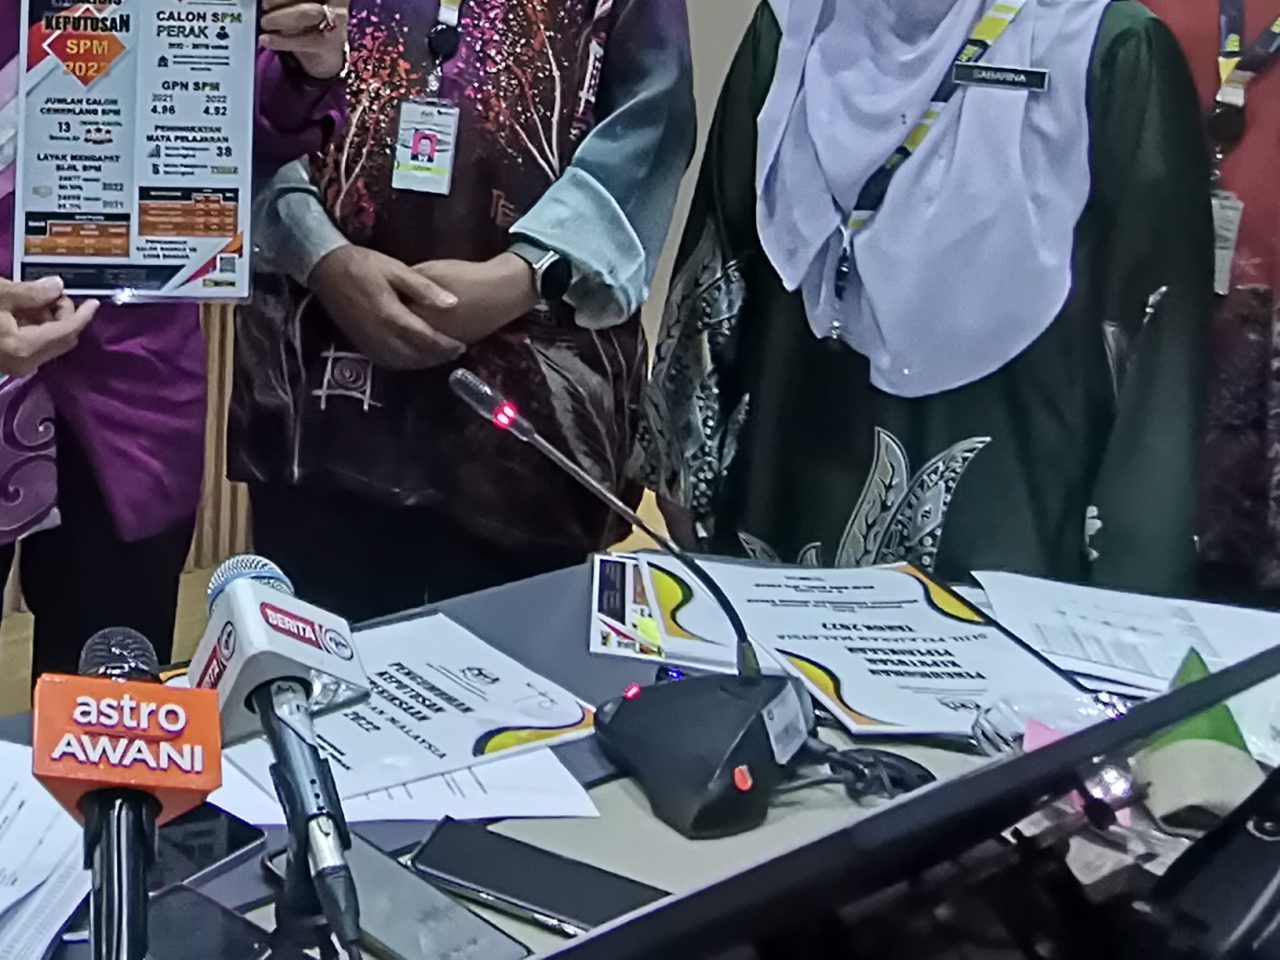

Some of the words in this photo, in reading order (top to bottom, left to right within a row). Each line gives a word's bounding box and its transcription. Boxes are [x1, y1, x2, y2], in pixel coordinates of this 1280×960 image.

[156, 10, 208, 23] CALON
[211, 11, 243, 24] SPM
[156, 25, 209, 39] PERAK
[65, 39, 109, 55] SPM
[265, 608, 317, 641] BERITA
[72, 693, 187, 733] astro
[50, 732, 204, 774] AWANI
